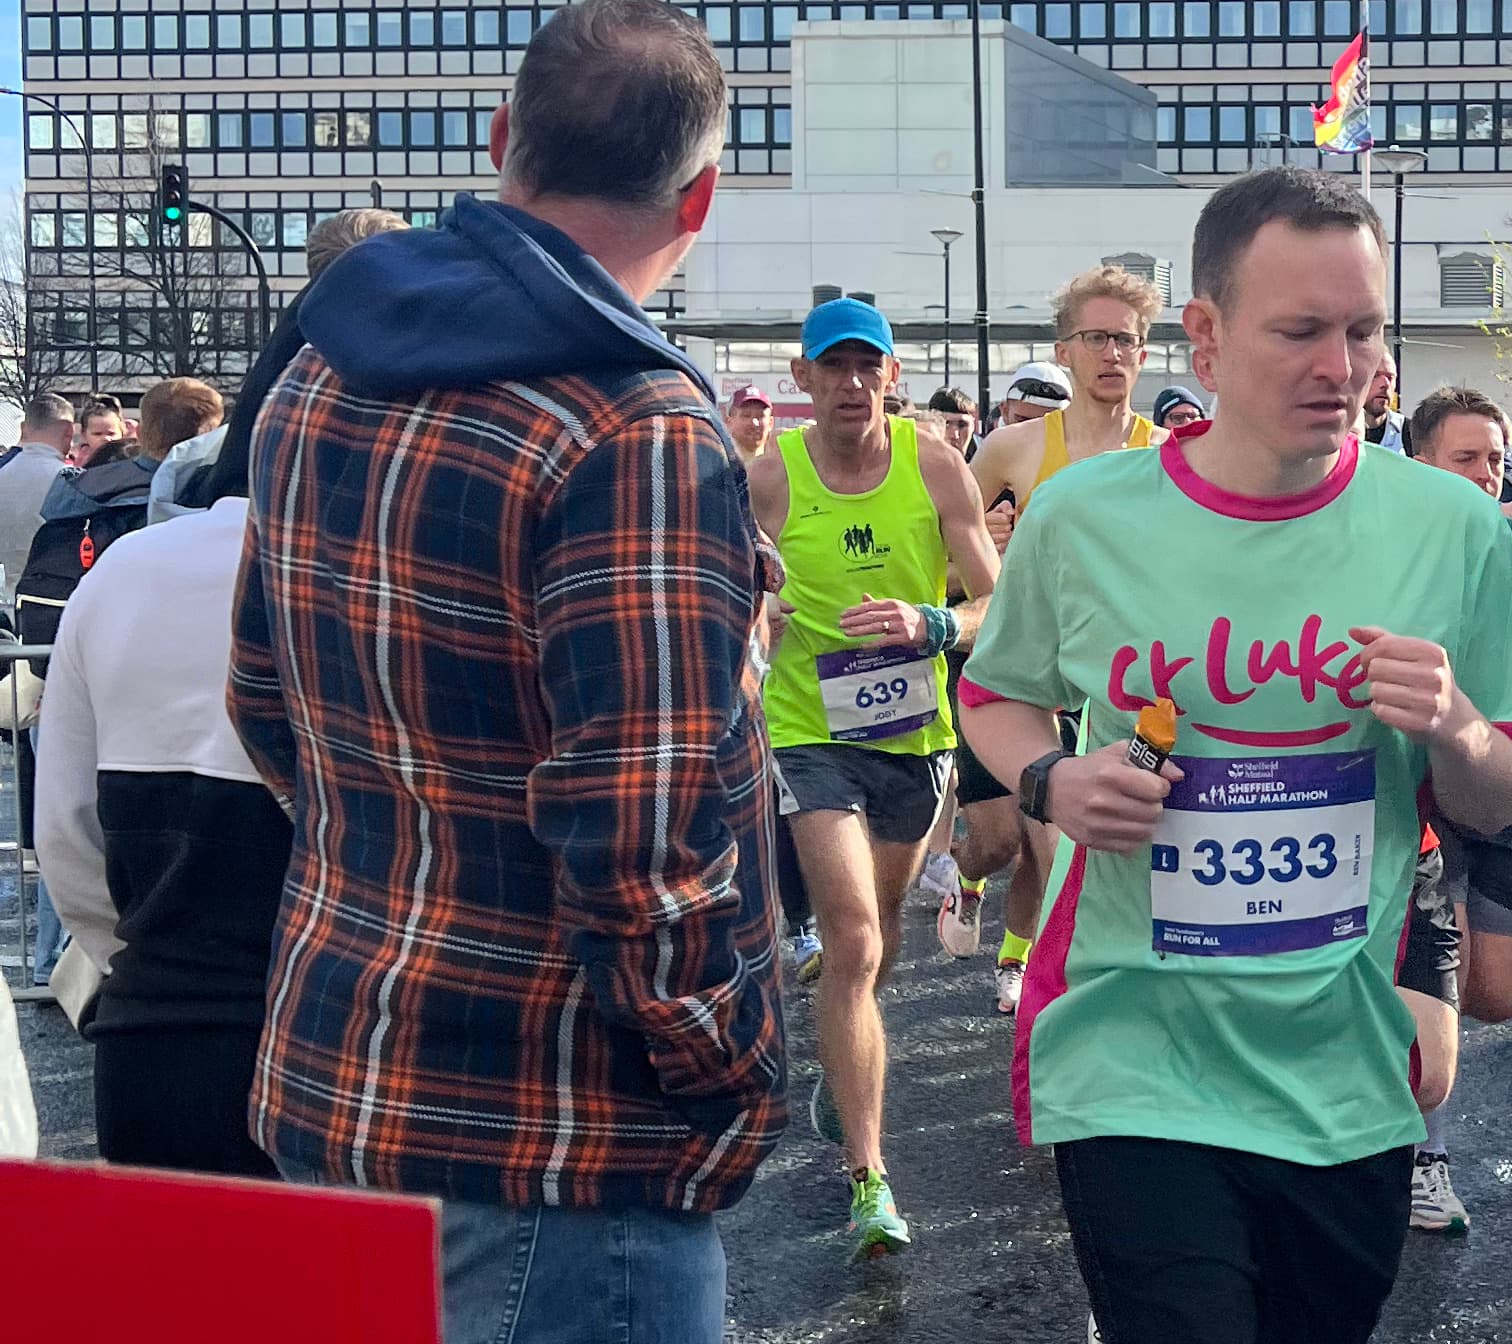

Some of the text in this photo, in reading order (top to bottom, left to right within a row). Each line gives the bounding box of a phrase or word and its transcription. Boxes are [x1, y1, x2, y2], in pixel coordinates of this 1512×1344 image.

[855, 677, 908, 709] 639
[1228, 781, 1285, 794] SHEFFIELD
[1228, 789, 1328, 805] HALF MARATHON
[1191, 833, 1338, 886] 3333
[1246, 899, 1282, 916] BEN
[1182, 935, 1201, 945] FOR
[1202, 936, 1221, 946] ALL
